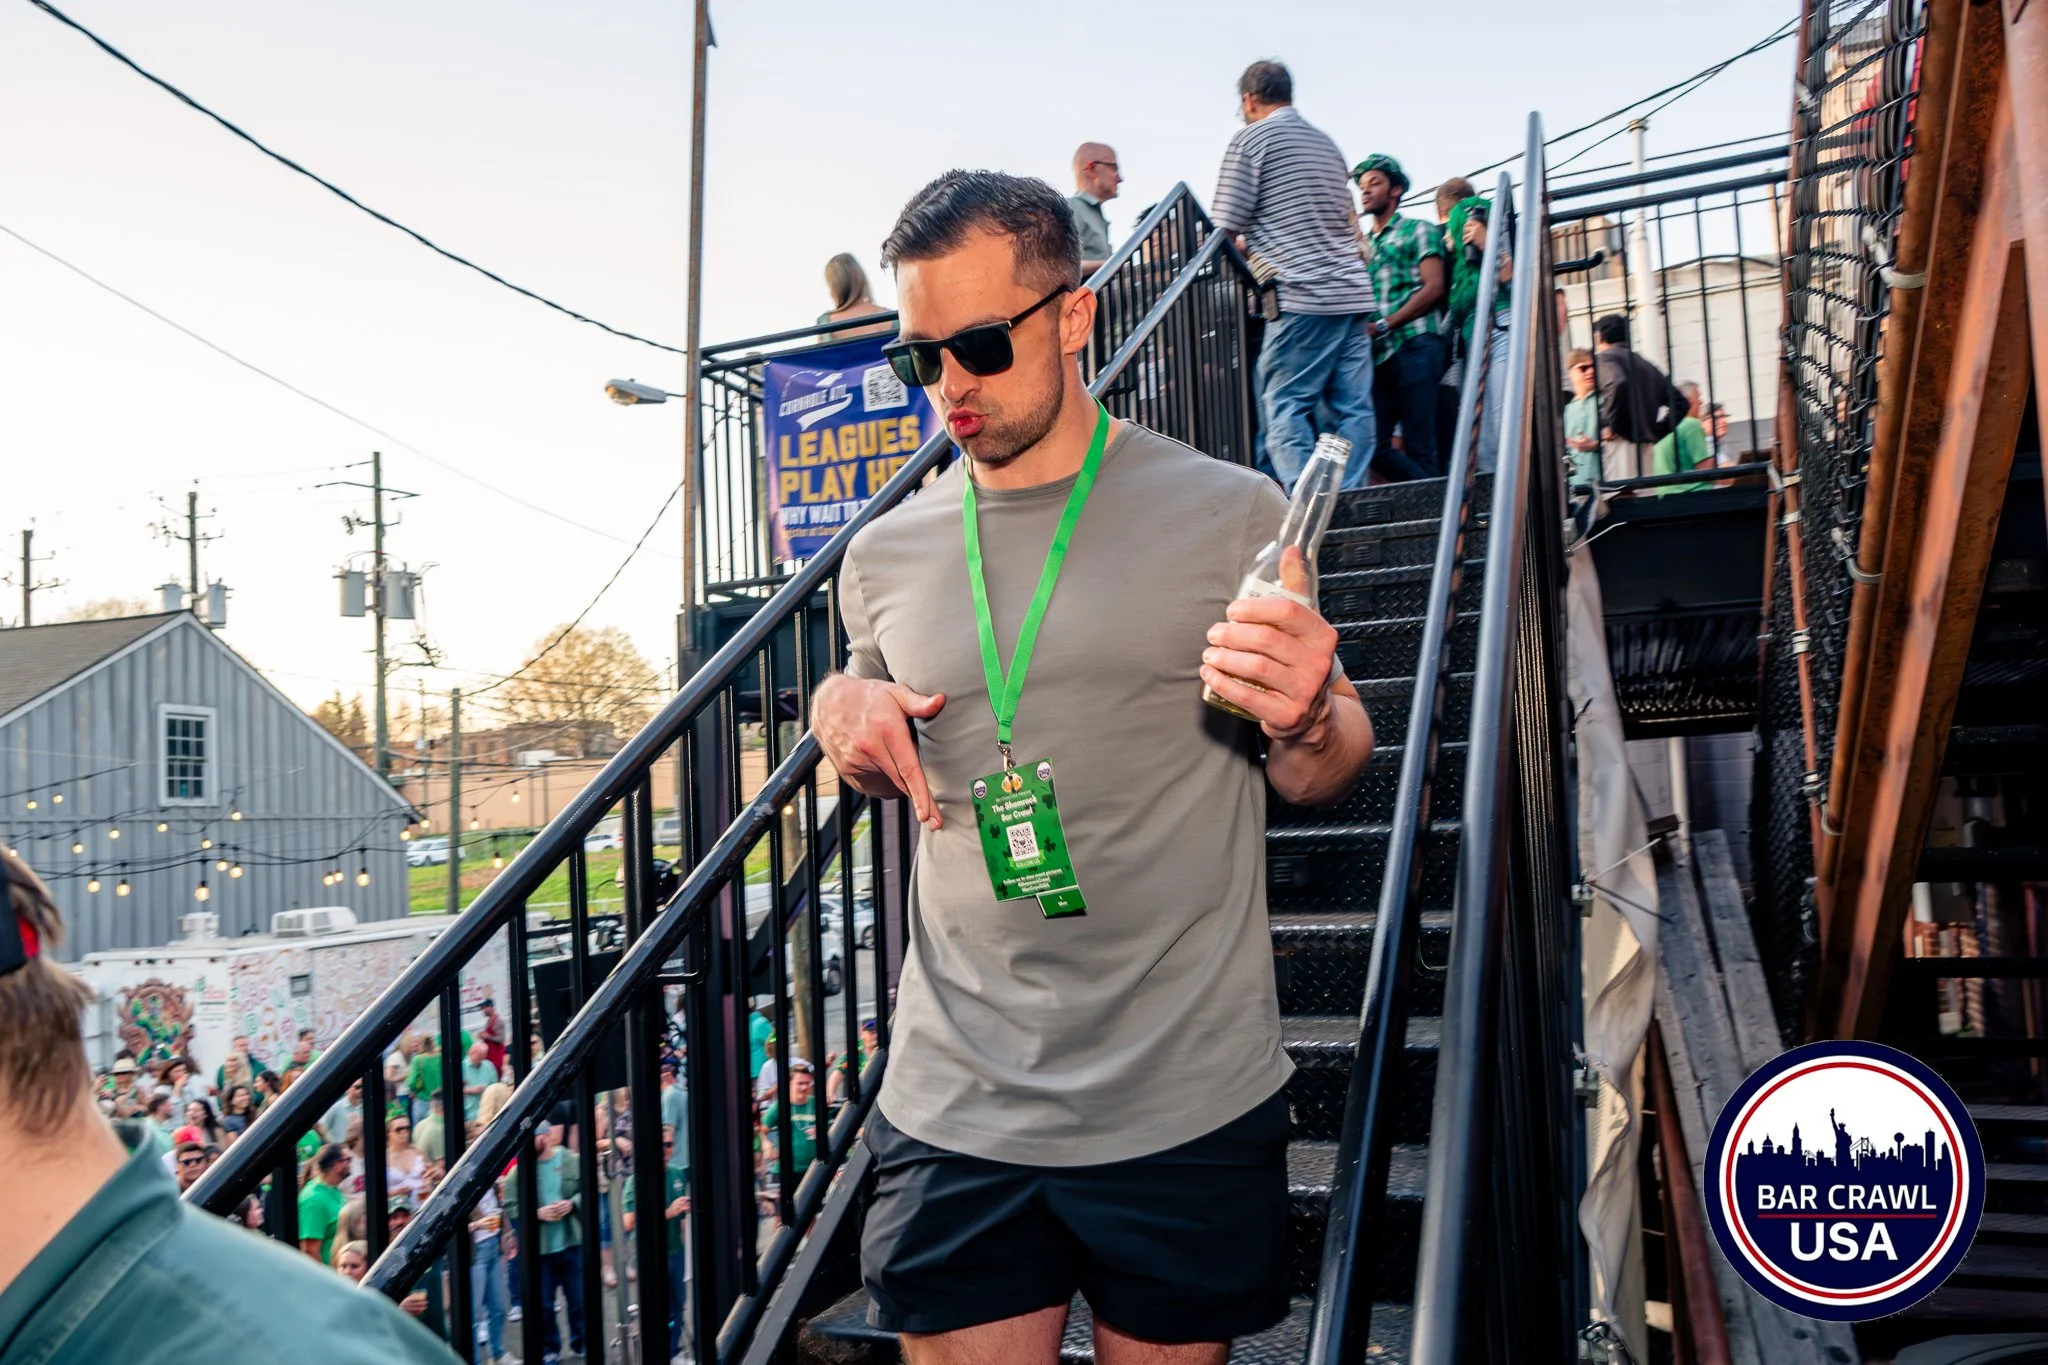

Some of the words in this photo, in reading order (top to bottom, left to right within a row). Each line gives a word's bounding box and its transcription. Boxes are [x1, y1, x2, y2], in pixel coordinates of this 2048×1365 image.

[780, 415, 920, 468] LEAGUES
[780, 461, 859, 504] PLAY
[778, 505, 809, 526] WHY
[809, 502, 841, 525] WAIT
[992, 803, 1005, 814] The
[1005, 794, 1037, 810] Shamrock
[1001, 813, 1012, 822] Bar
[1012, 805, 1034, 819] Crawl
